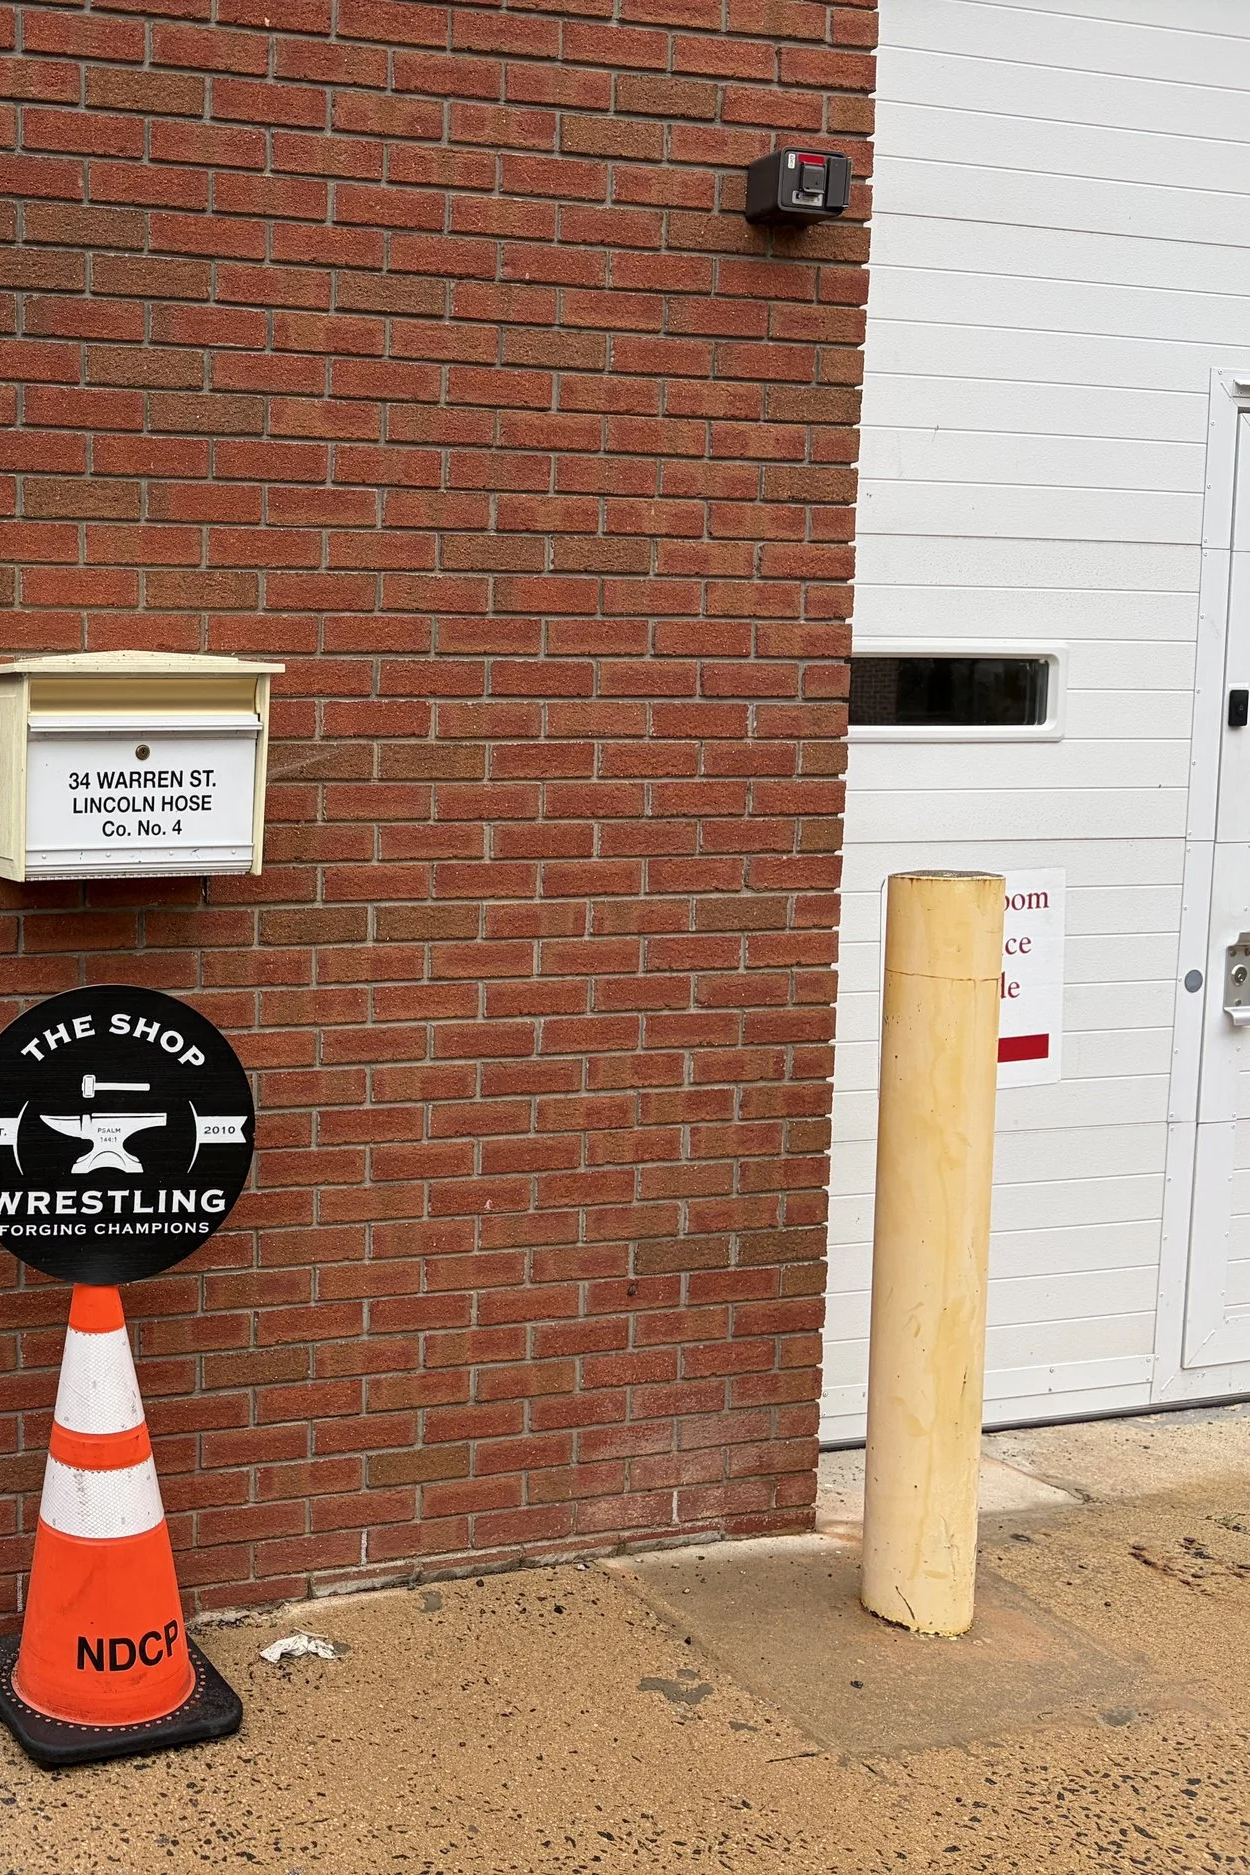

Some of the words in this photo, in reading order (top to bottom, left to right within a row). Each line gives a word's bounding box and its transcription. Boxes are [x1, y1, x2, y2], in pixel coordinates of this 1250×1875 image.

[68, 772, 91, 791] 34
[96, 770, 184, 790] WARREN
[189, 769, 217, 788] ST.
[72, 796, 155, 814] LINCOLN
[161, 794, 213, 812] HOSE
[101, 820, 132, 838] Co.
[137, 820, 167, 837] No.
[171, 819, 183, 836] 4
[20, 1014, 96, 1062] THE
[108, 1013, 206, 1066] SHOP
[203, 1125, 236, 1135] 2010
[94, 1222, 210, 1235] CHAMPIONS
[77, 1620, 179, 1672] NDCP
